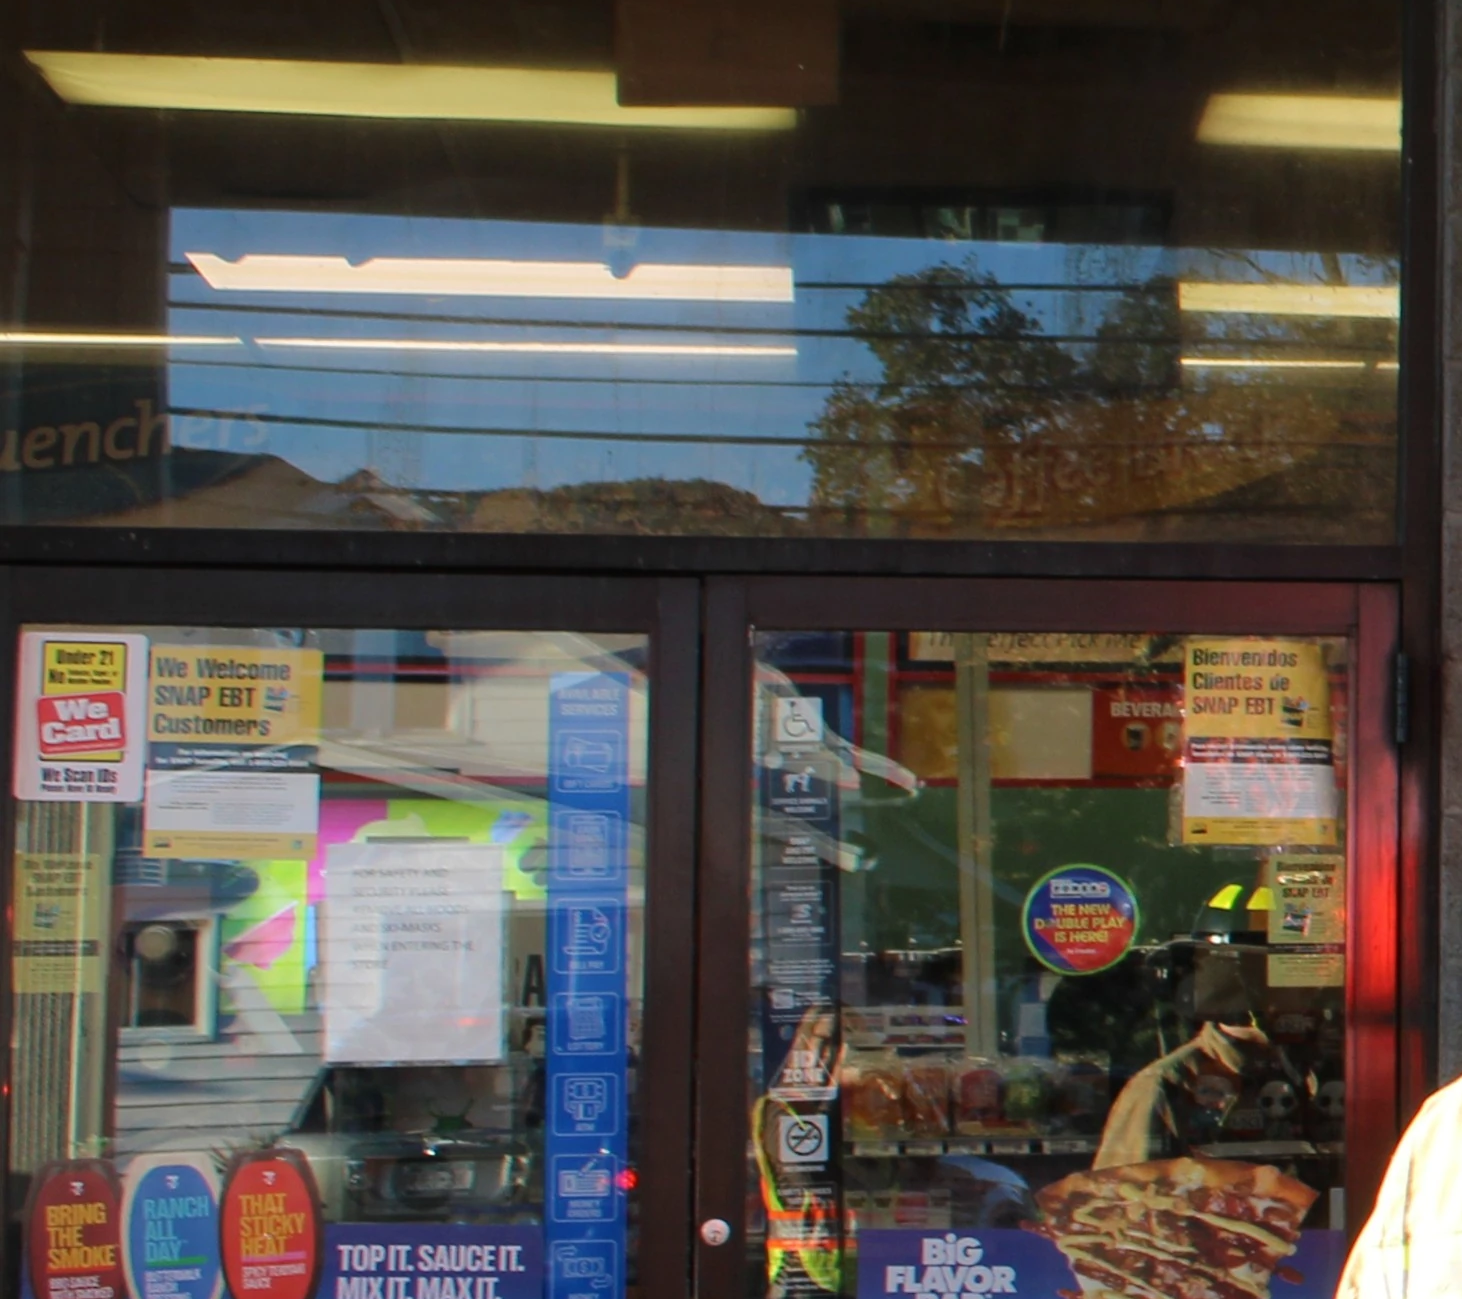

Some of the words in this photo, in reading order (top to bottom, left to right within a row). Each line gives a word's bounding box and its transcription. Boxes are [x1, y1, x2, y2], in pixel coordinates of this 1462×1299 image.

[56, 649, 97, 666] Under
[99, 650, 115, 664] 21
[156, 657, 188, 679] We
[196, 657, 292, 681] Welcome
[1192, 648, 1298, 668] Bienvenidos
[48, 670, 65, 684] No
[1192, 671, 1263, 691] Clientes
[1269, 673, 1291, 691] de
[154, 685, 212, 707] SNAP
[217, 686, 257, 708] EBT
[1192, 696, 1239, 715] SNAP
[1245, 697, 1275, 715] EBT
[53, 699, 109, 721] We
[560, 703, 618, 716] SERVICES
[40, 718, 122, 745] Card
[153, 713, 271, 737] Customers
[41, 768, 61, 783] We
[63, 768, 94, 783] Scan
[1078, 903, 1111, 916] NEW
[46, 1203, 107, 1226] BRING
[142, 1195, 210, 1220] RANCH
[240, 1193, 288, 1216] THAT
[48, 1226, 83, 1247] THE
[144, 1219, 179, 1240] ALL
[240, 1212, 306, 1238] STICKY
[47, 1245, 117, 1269] SMOKE
[144, 1240, 182, 1262] DAY
[241, 1235, 288, 1258] HEAT
[922, 1233, 984, 1267] BiG
[338, 1245, 383, 1272] TOP
[386, 1245, 416, 1272] IT.
[417, 1245, 494, 1271] SAUCE
[497, 1246, 525, 1272] IT.
[885, 1265, 1018, 1294] FLAVOR
